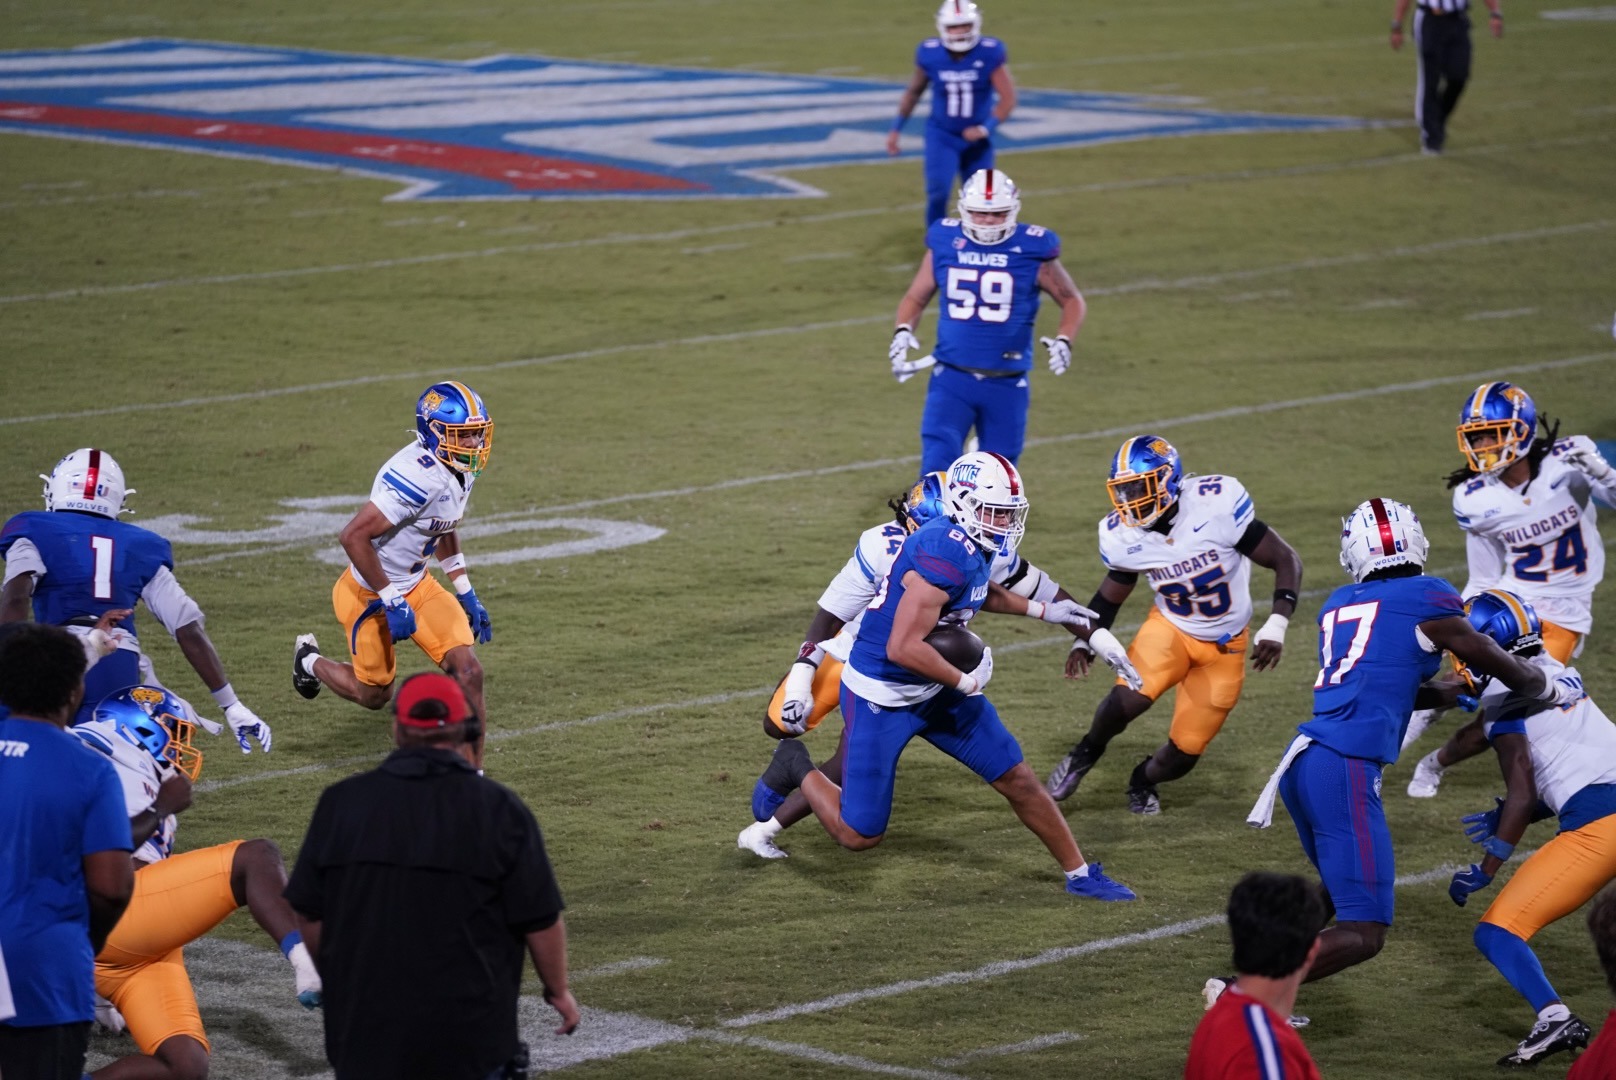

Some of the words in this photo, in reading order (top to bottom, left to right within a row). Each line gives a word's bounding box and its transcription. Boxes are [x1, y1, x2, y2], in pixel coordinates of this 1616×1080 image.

[945, 82, 973, 118] 11
[957, 250, 1008, 268] WOLVES
[947, 267, 1013, 323] 59
[417, 454, 436, 469] 9
[66, 502, 109, 514] WOLVES
[1501, 505, 1578, 545] WILDCATS
[90, 535, 114, 600] 1
[1149, 548, 1219, 582] WILDCATS
[1374, 555, 1406, 567] WOLVES
[1511, 521, 1588, 583] 24
[1313, 600, 1381, 691] 17
